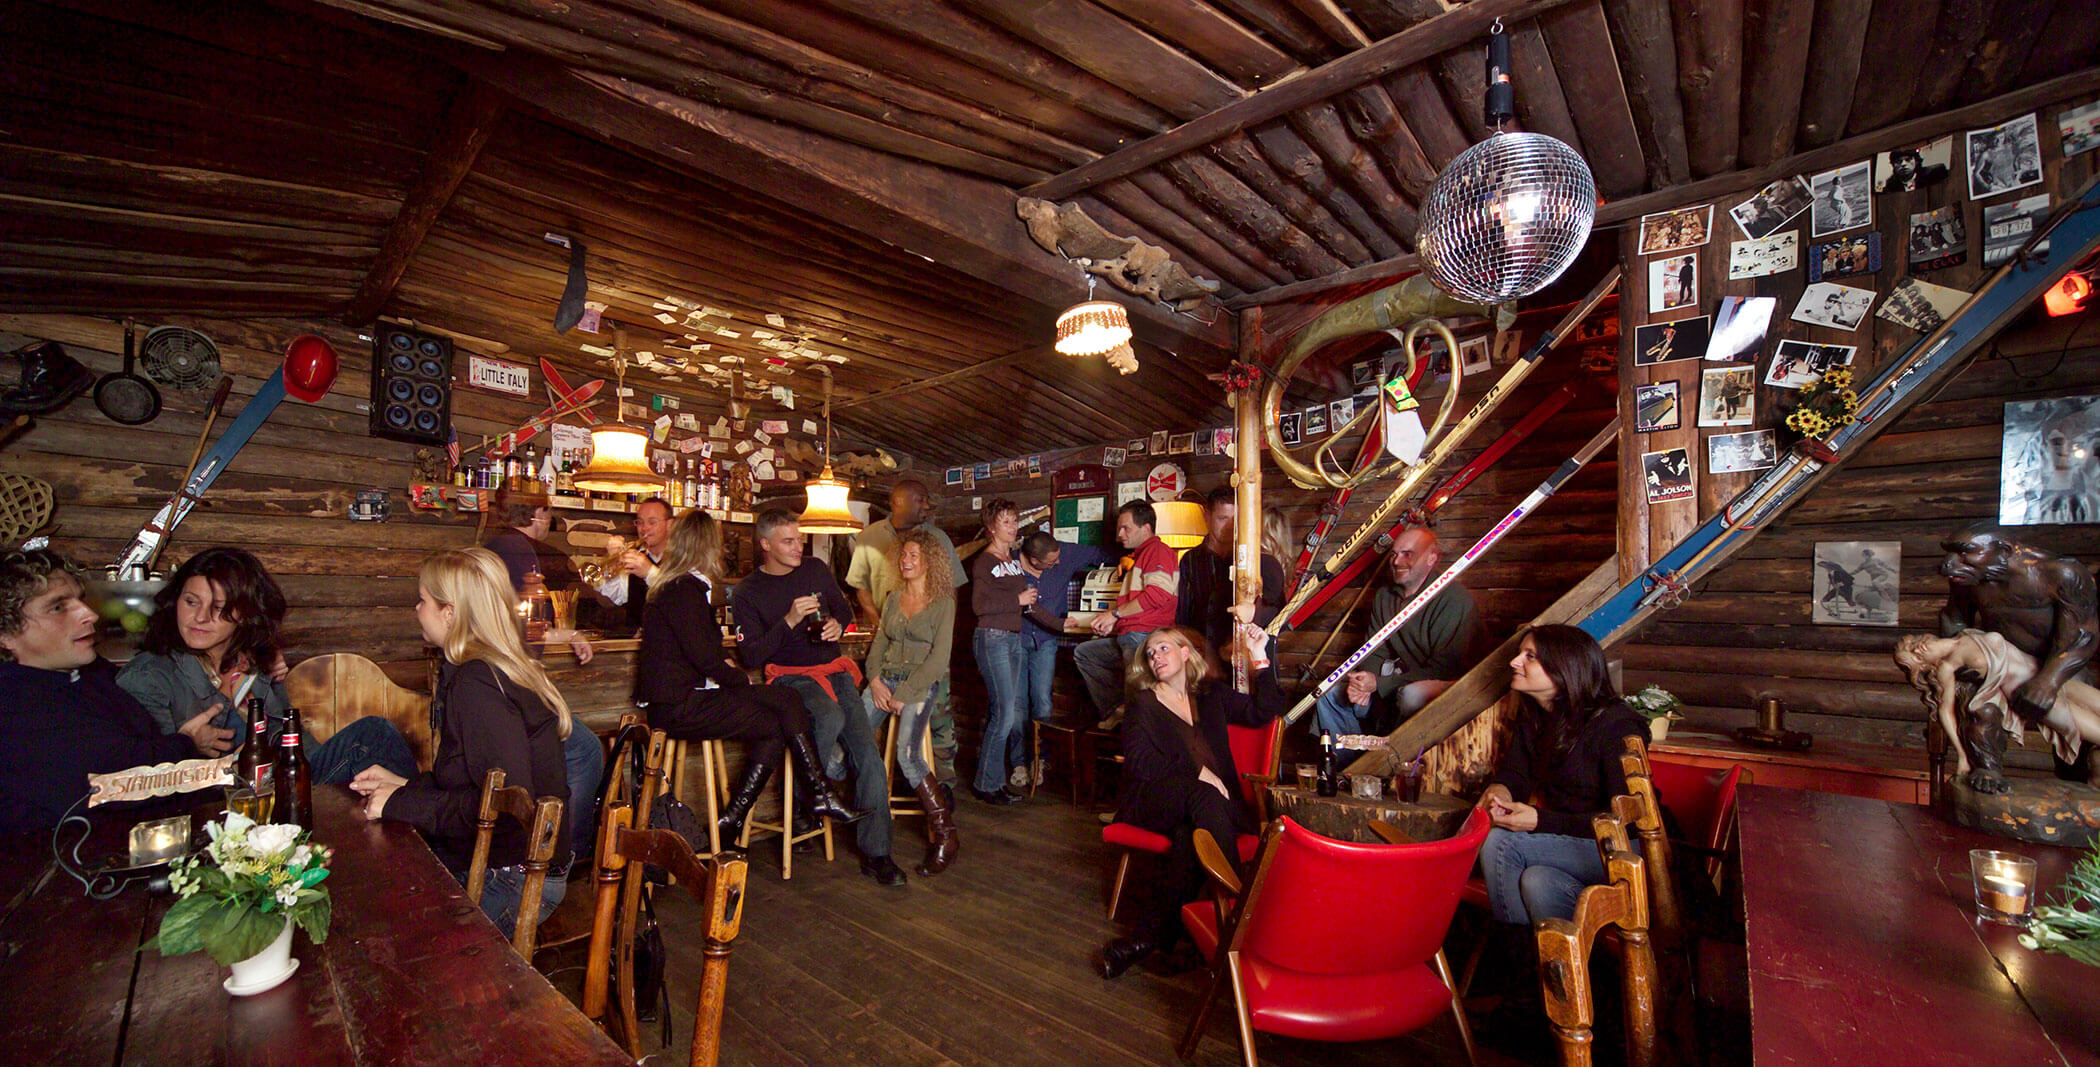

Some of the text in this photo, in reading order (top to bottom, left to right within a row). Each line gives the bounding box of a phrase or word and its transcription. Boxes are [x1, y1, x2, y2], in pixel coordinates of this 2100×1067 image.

[481, 367, 528, 389] LITTLE ITALY
[1468, 384, 1501, 420] USA
[1661, 484, 1692, 495] JOLSON
[1375, 569, 1455, 644] Whitefibre
[1326, 641, 1372, 684] KOHO
